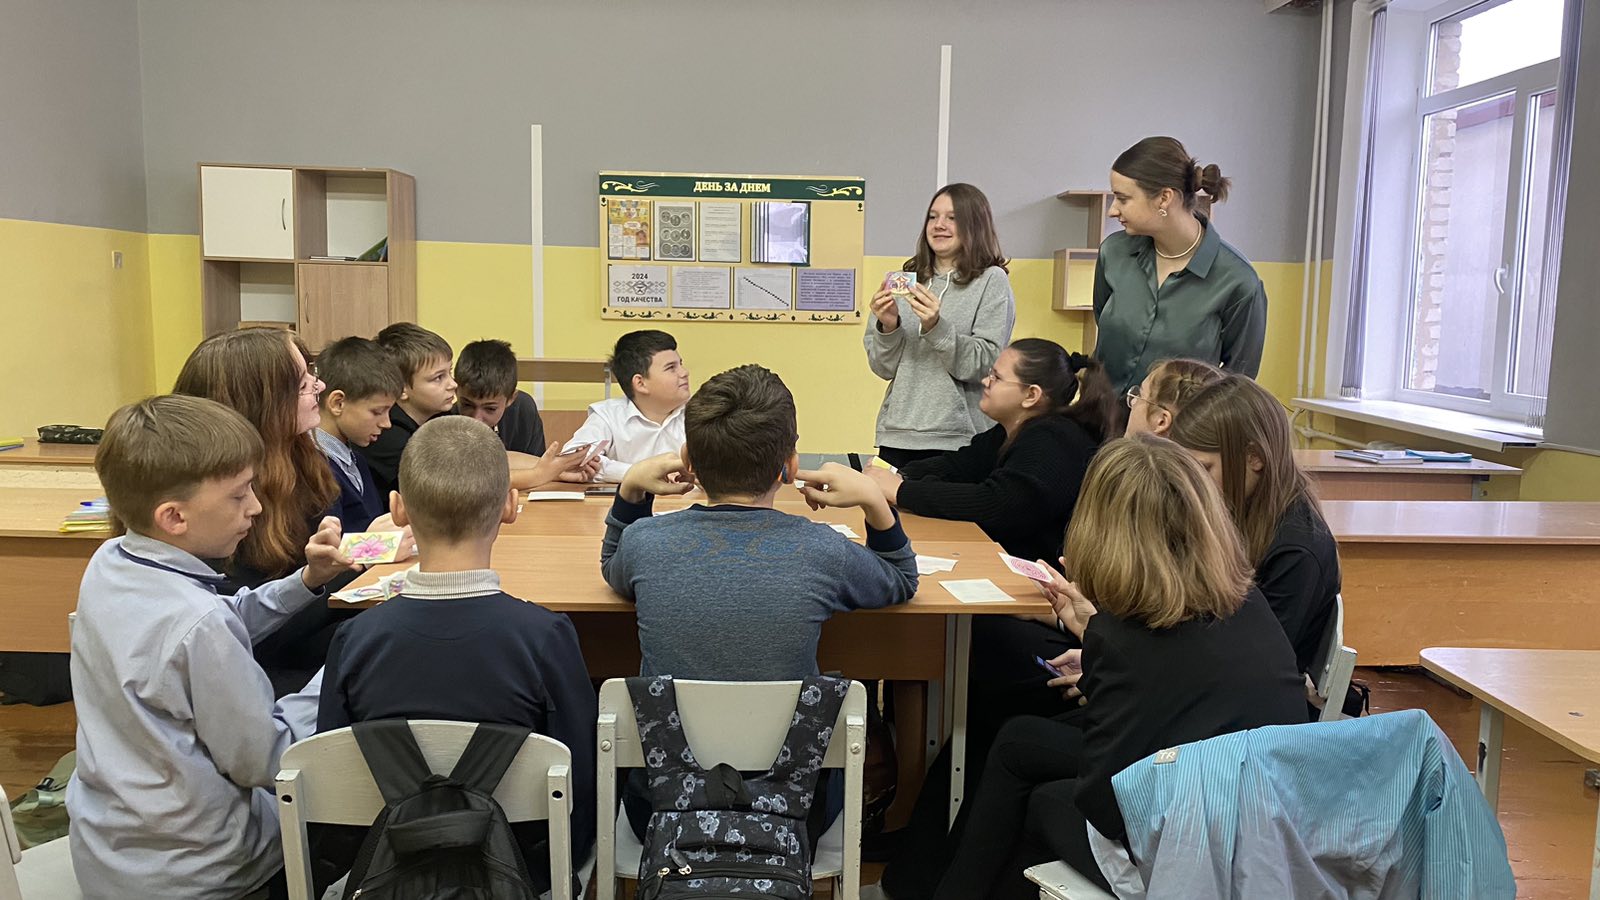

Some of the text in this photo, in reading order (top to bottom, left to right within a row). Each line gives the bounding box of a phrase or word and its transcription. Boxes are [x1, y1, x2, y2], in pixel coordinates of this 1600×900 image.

[693, 181, 771, 194] ДЕНЬ ЗА ДНЕМ
